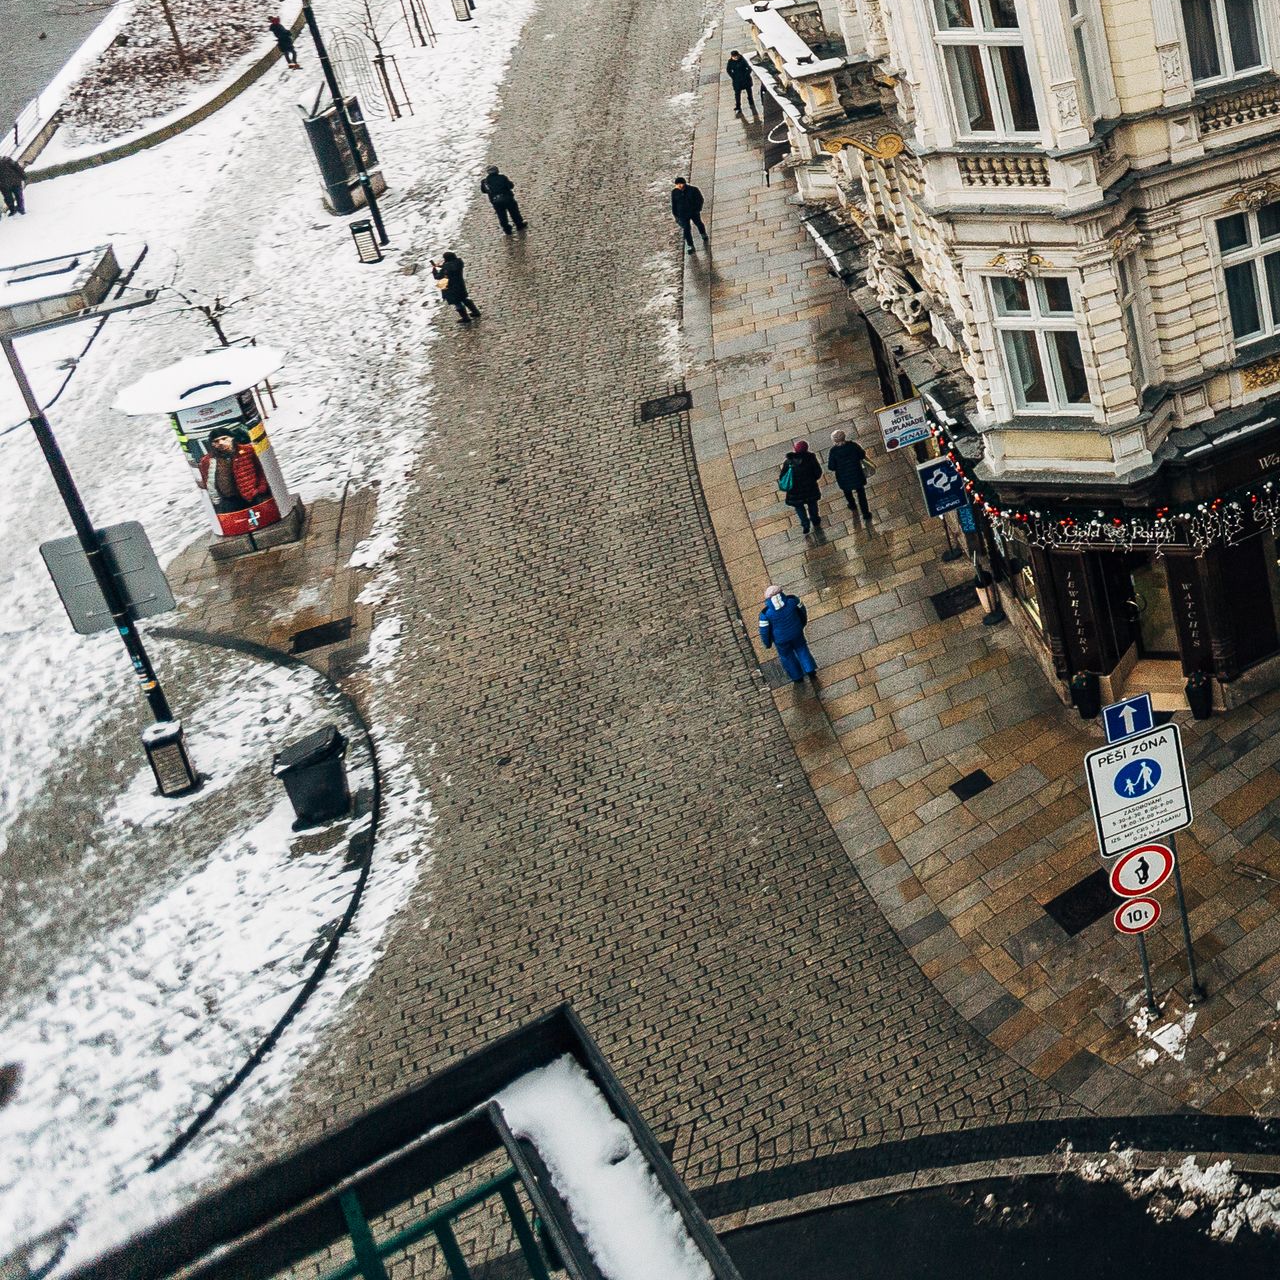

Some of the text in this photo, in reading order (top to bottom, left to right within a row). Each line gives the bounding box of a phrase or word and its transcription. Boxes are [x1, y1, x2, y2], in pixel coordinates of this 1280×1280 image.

[885, 416, 924, 435] ESPLANADE
[891, 414, 914, 425] HOTEL
[1064, 523, 1171, 539] Gold Point
[1066, 571, 1088, 654] JEWELLERY
[1181, 583, 1201, 647] WATCHES
[1098, 735, 1169, 768] PĚŠÍ ZÓNA
